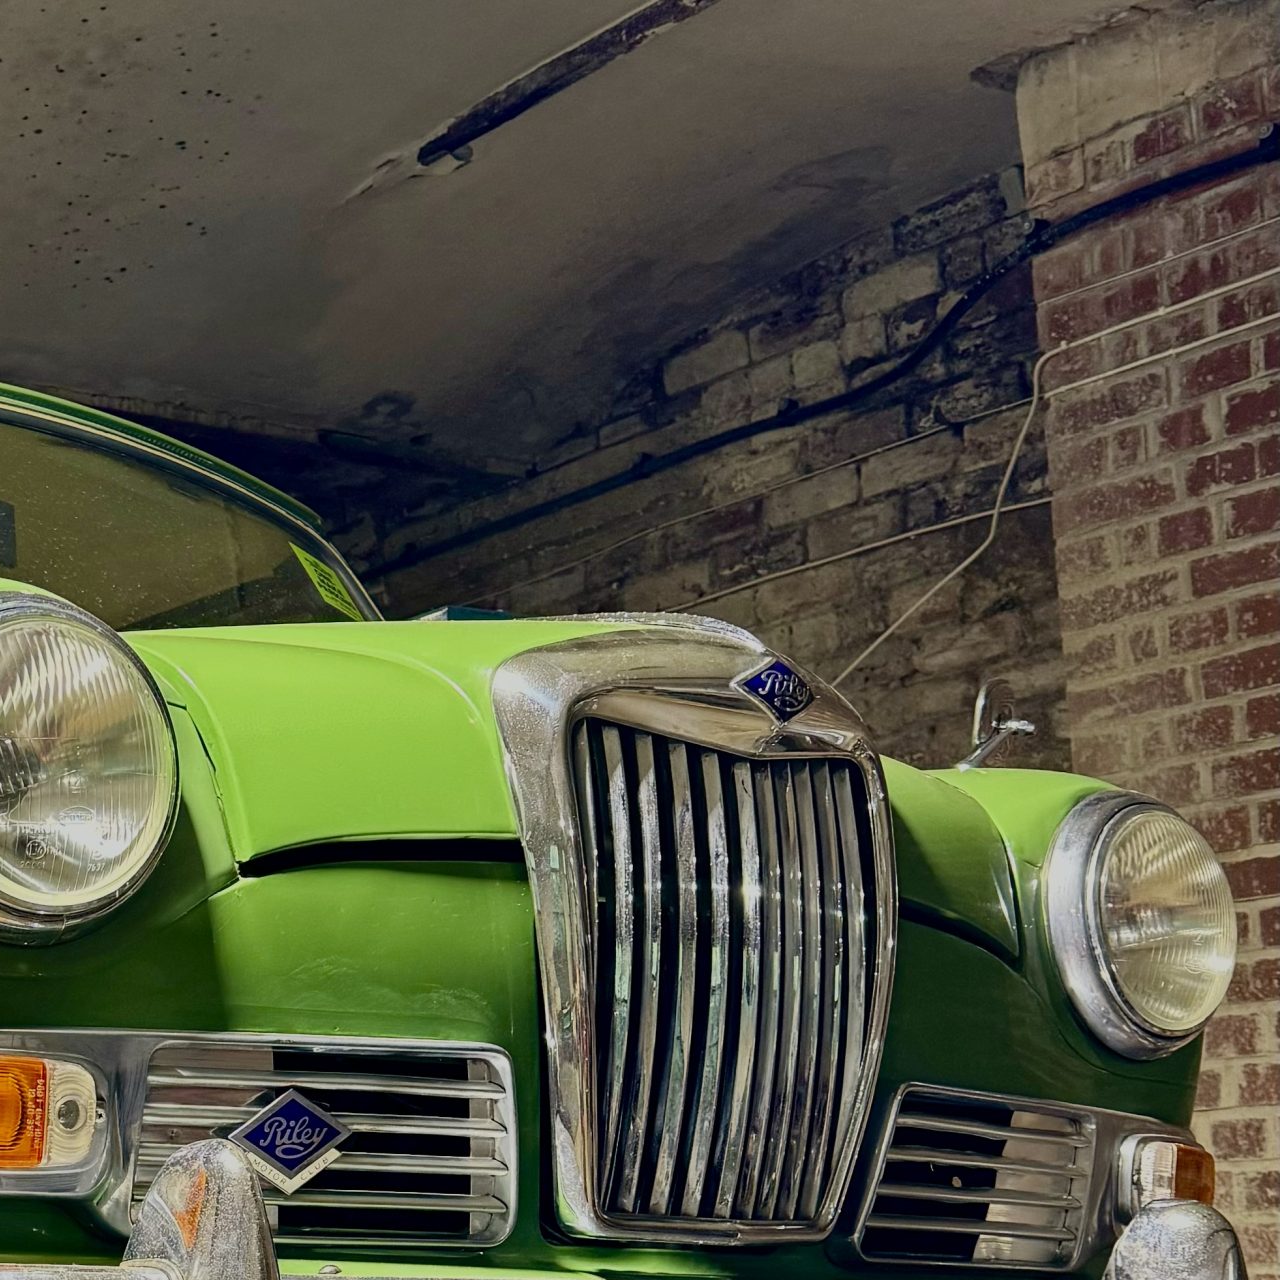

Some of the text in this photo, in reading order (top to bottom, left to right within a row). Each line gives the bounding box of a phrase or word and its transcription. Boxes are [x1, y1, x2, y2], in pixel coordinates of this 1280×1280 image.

[758, 670, 809, 712] Riley
[259, 1116, 328, 1159] Riley
[253, 1157, 329, 1185] MOTOR CLUB
